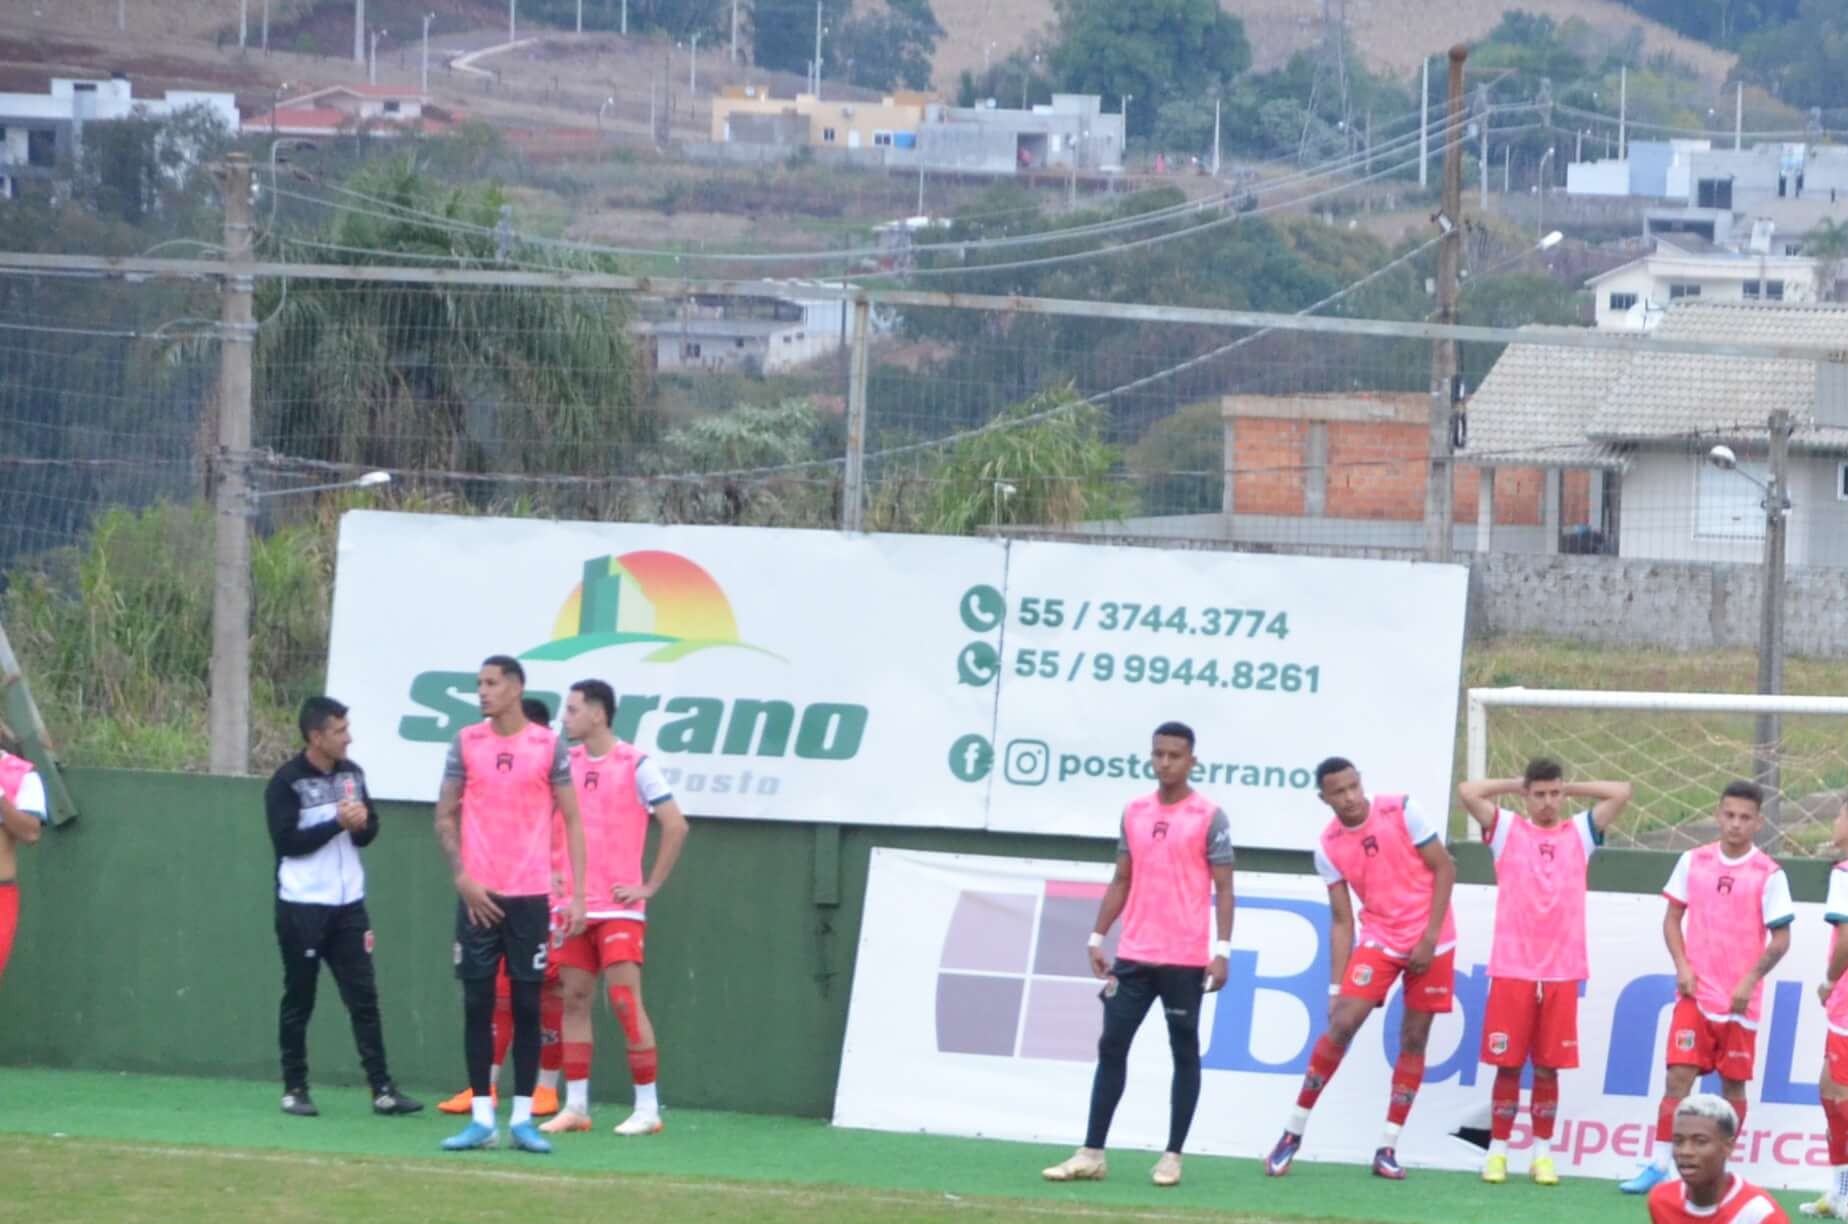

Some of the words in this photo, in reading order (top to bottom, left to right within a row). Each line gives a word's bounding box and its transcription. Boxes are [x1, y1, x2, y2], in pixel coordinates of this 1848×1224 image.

[1018, 596, 1064, 628] 55
[1072, 602, 1090, 631] /
[1098, 601, 1289, 640] 3744.3774
[1014, 648, 1060, 679] 55
[1067, 652, 1085, 682] /
[1092, 653, 1115, 682] 9
[1124, 655, 1320, 694] 9944.8261
[399, 670, 868, 760] Srano
